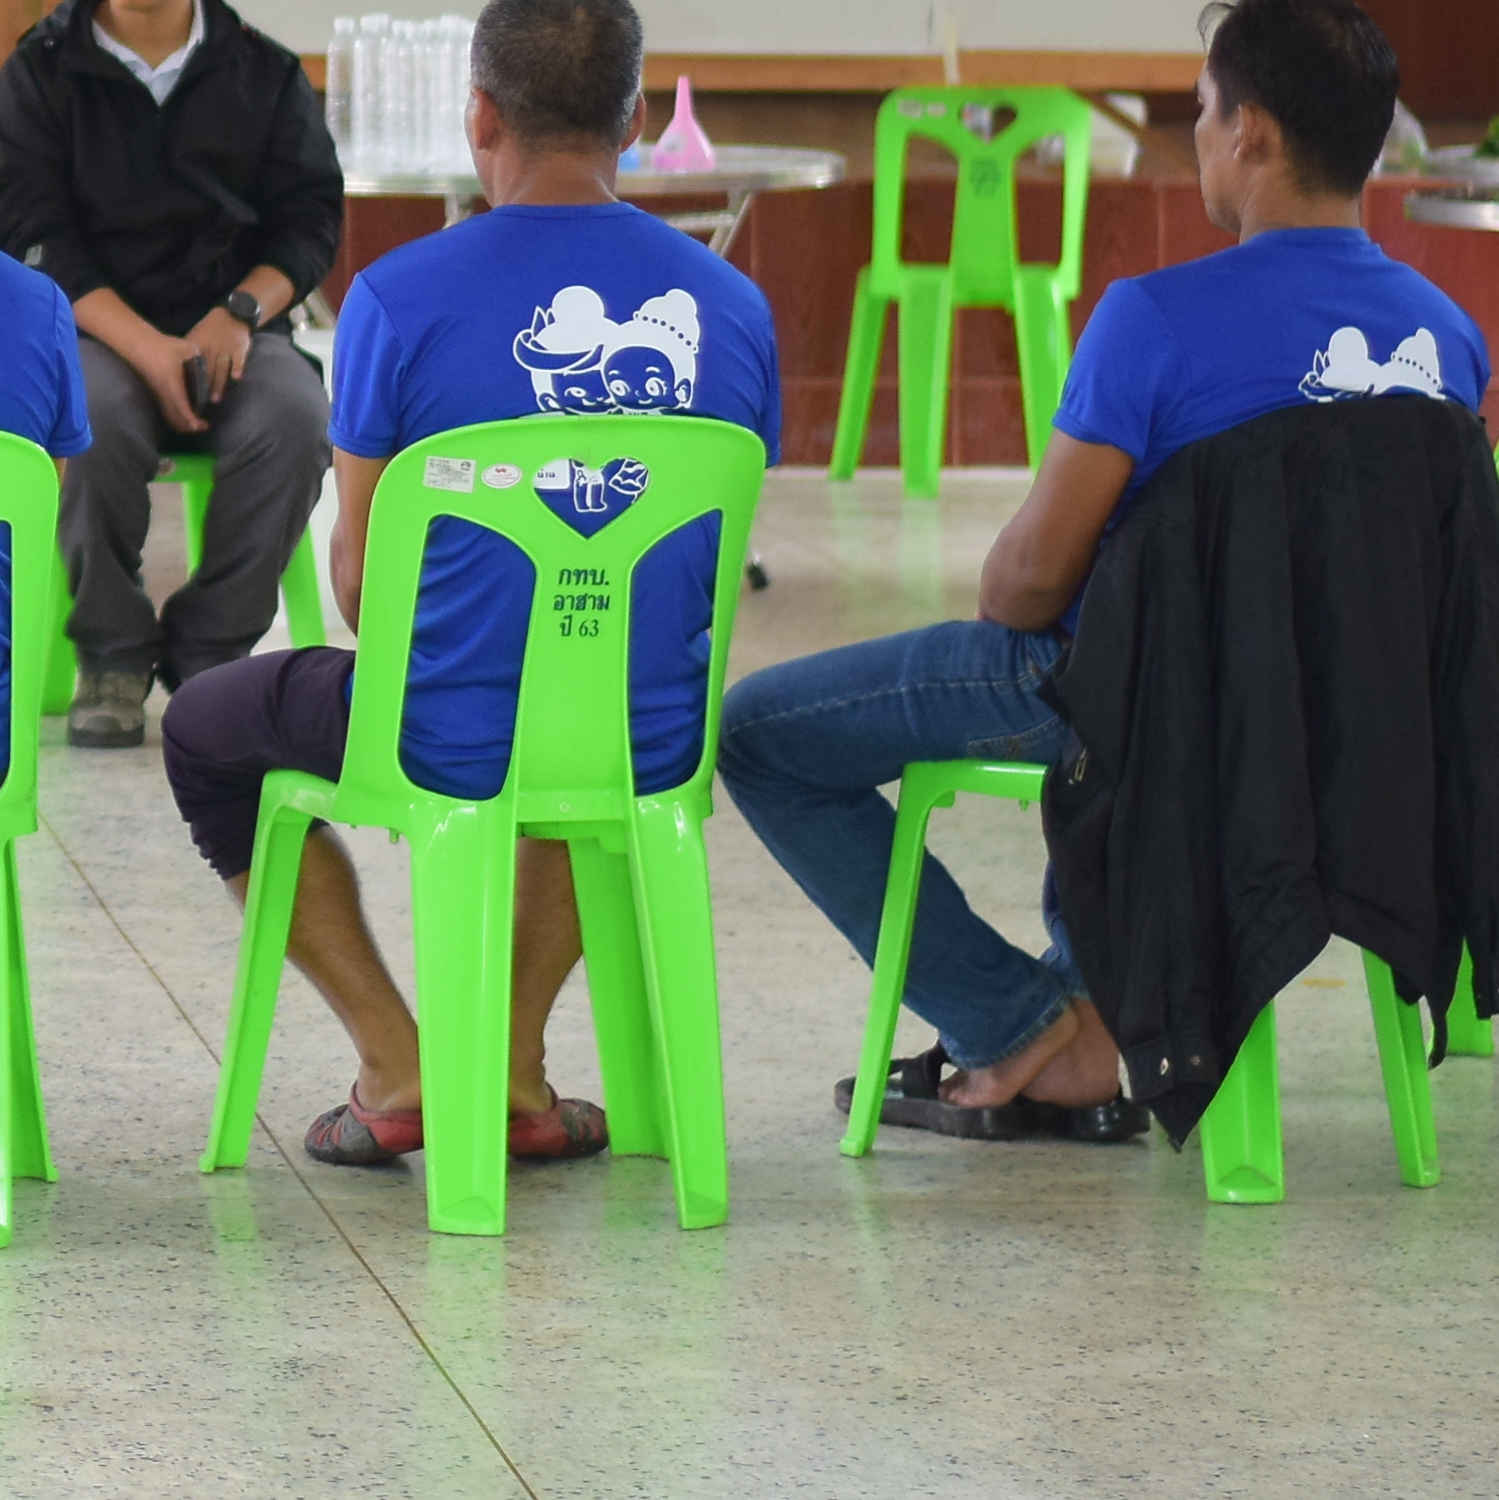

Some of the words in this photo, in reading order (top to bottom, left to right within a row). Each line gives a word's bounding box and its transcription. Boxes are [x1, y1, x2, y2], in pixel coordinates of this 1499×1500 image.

[558, 566, 610, 587] กทบ.
[553, 593, 610, 612] อาฮาม
[559, 616, 572, 638] ปี
[578, 619, 599, 638] 63
